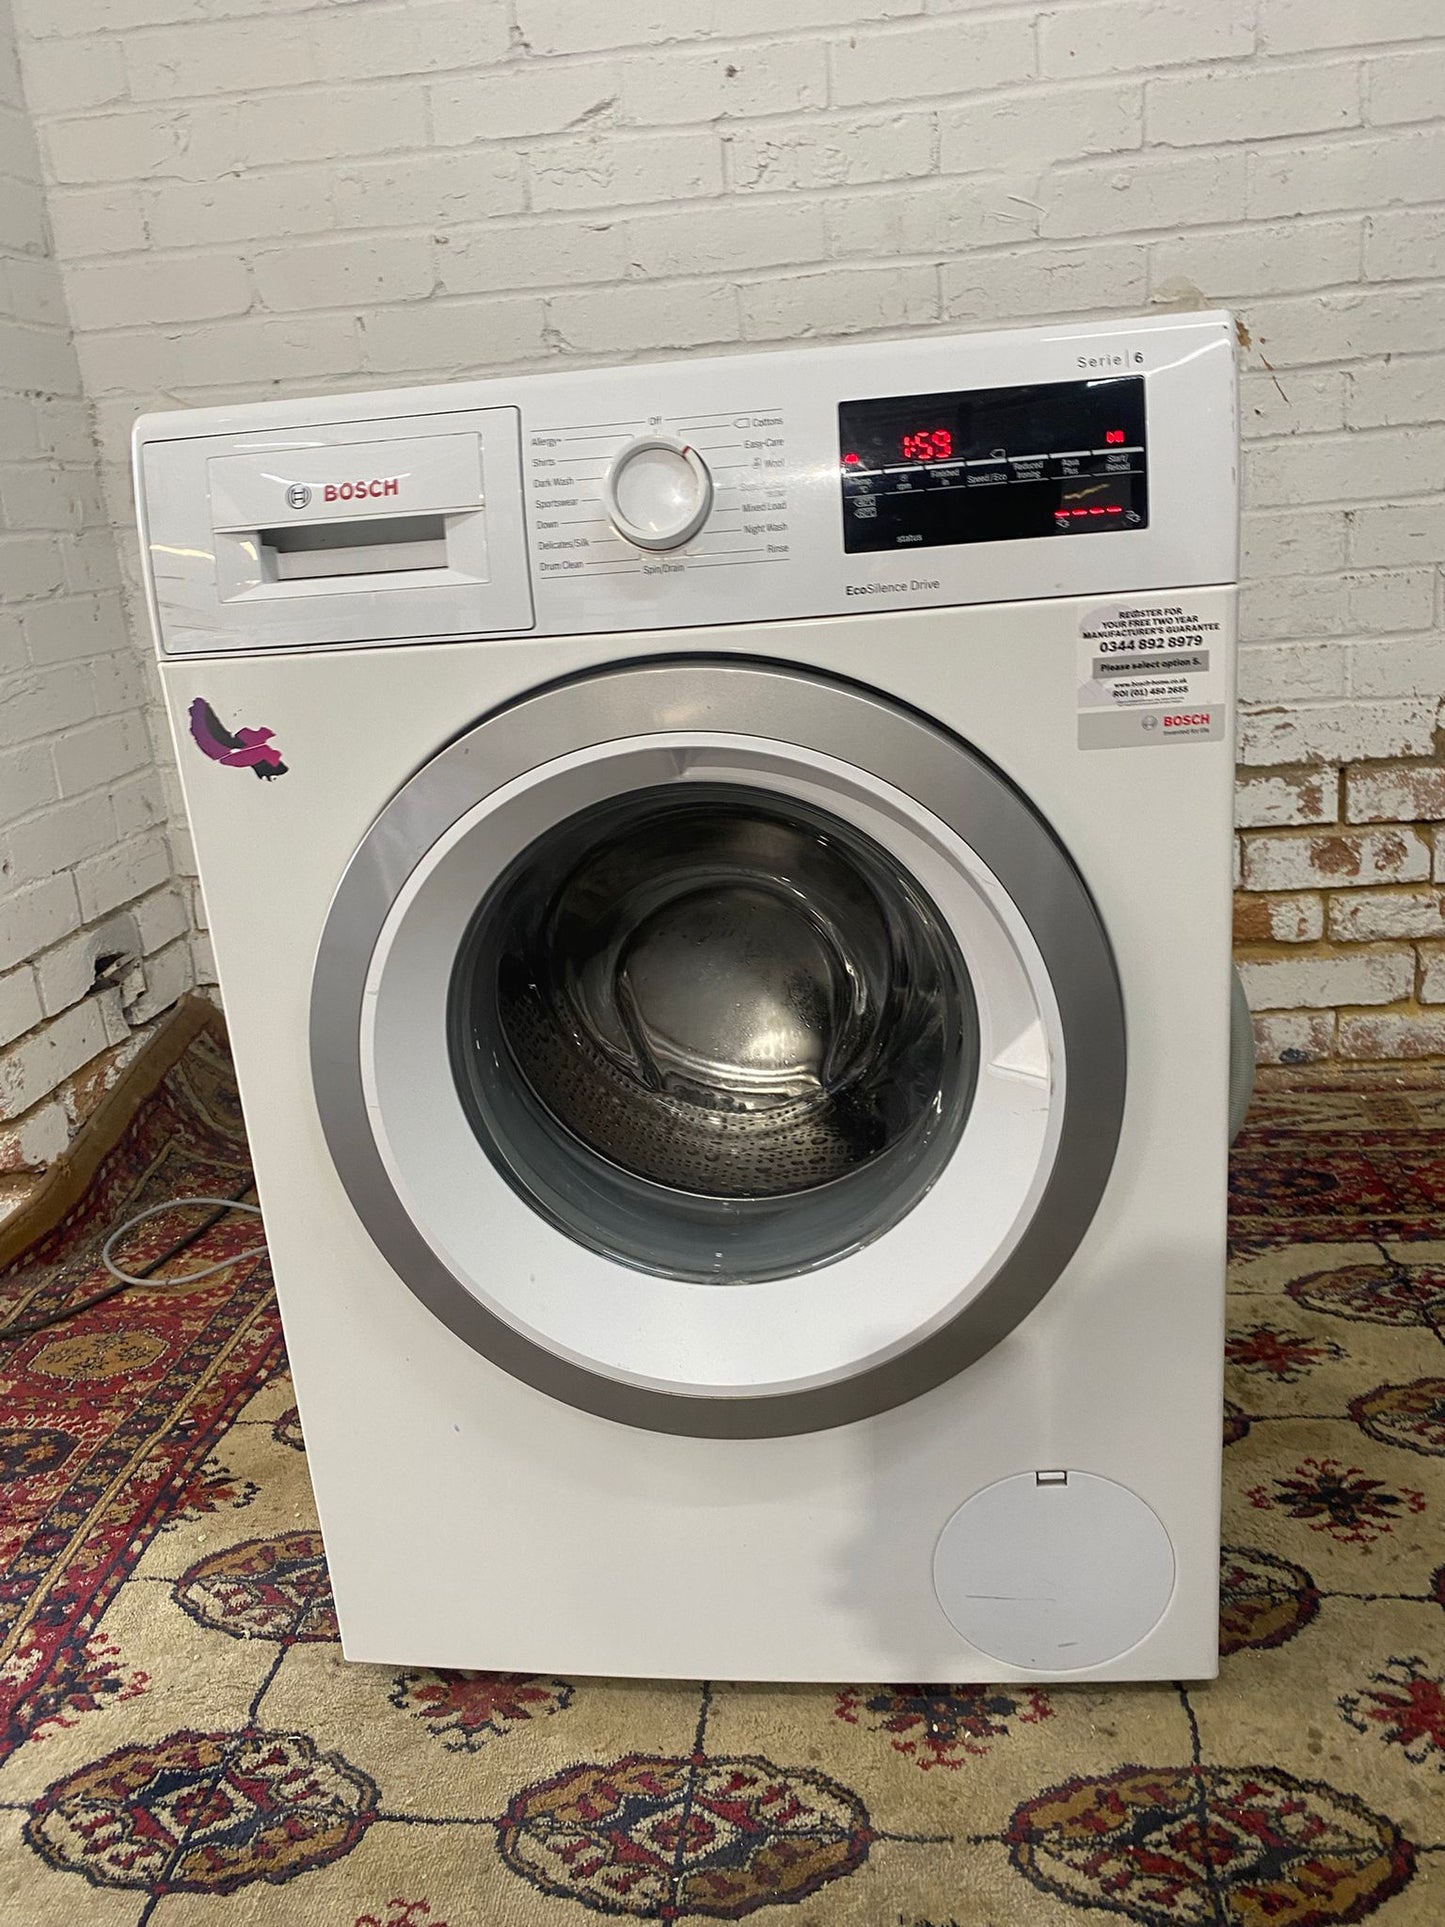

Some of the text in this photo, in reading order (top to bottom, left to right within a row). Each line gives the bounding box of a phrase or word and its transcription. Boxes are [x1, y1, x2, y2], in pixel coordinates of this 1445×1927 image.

[1077, 352, 1144, 369] Serie 6
[648, 416, 662, 426] Off
[753, 418, 784, 427] Cottons
[744, 438, 785, 449] Easy-Care
[532, 458, 556, 468] Shirts
[764, 458, 785, 468] Wool
[1013, 461, 1044, 471] Reduced
[533, 477, 575, 488] Dark Wash
[323, 478, 400, 502] BOSCH
[535, 499, 579, 509] Sportswear
[742, 502, 787, 512] Mixed Load
[536, 520, 559, 530] Down
[743, 523, 789, 535] Night Wash
[896, 534, 923, 543] status
[767, 544, 790, 553] Rinse
[539, 560, 585, 571] Drum Clean
[643, 563, 685, 575] Spin/Drain
[846, 579, 940, 596] EcoSilence Drive
[1119, 607, 1183, 619] REGISTER FOR
[1102, 615, 1199, 629] YOUR FREE TWO YEAR
[1083, 622, 1220, 639] MANUFACTURER'S GUARANTEE
[1100, 635, 1203, 653] 0344 892 8979
[1100, 663, 1130, 672] Please
[1132, 660, 1160, 671] select
[1161, 658, 1191, 669] option
[1112, 689, 1129, 698] ROI
[1163, 714, 1210, 727] BOSCH
